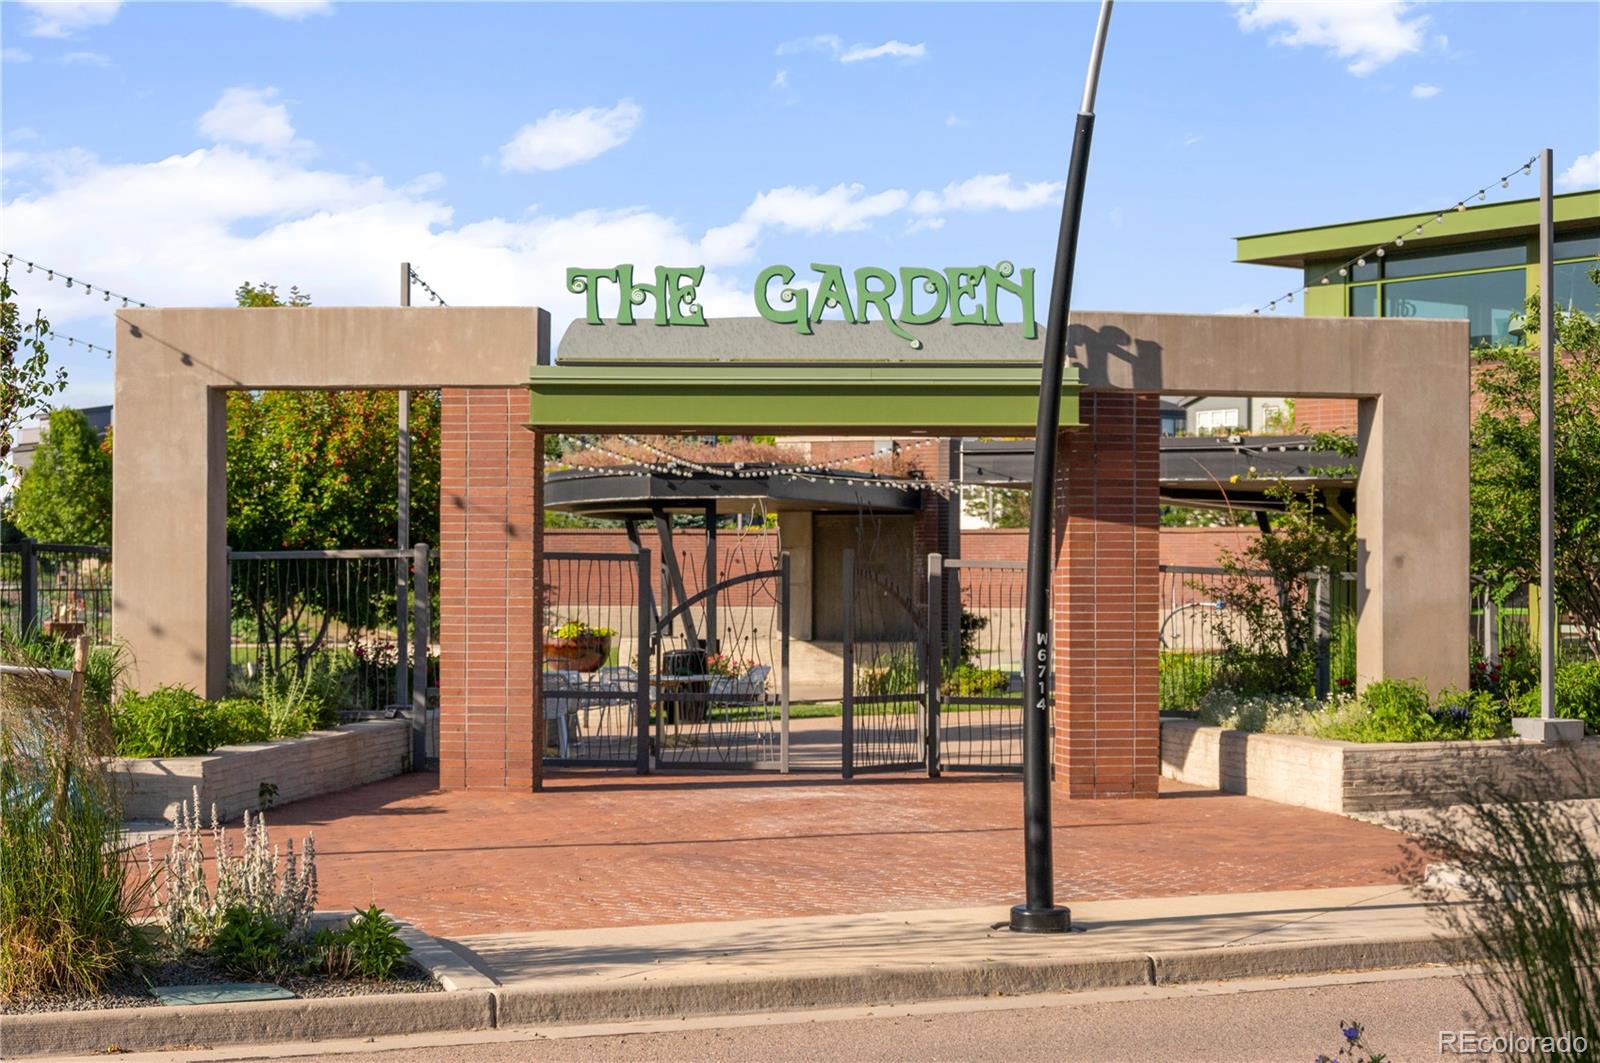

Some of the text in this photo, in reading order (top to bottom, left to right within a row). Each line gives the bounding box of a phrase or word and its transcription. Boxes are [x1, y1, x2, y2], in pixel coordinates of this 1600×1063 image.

[566, 260, 1037, 350] THE GARDEN
[1036, 632, 1048, 711] W6714
